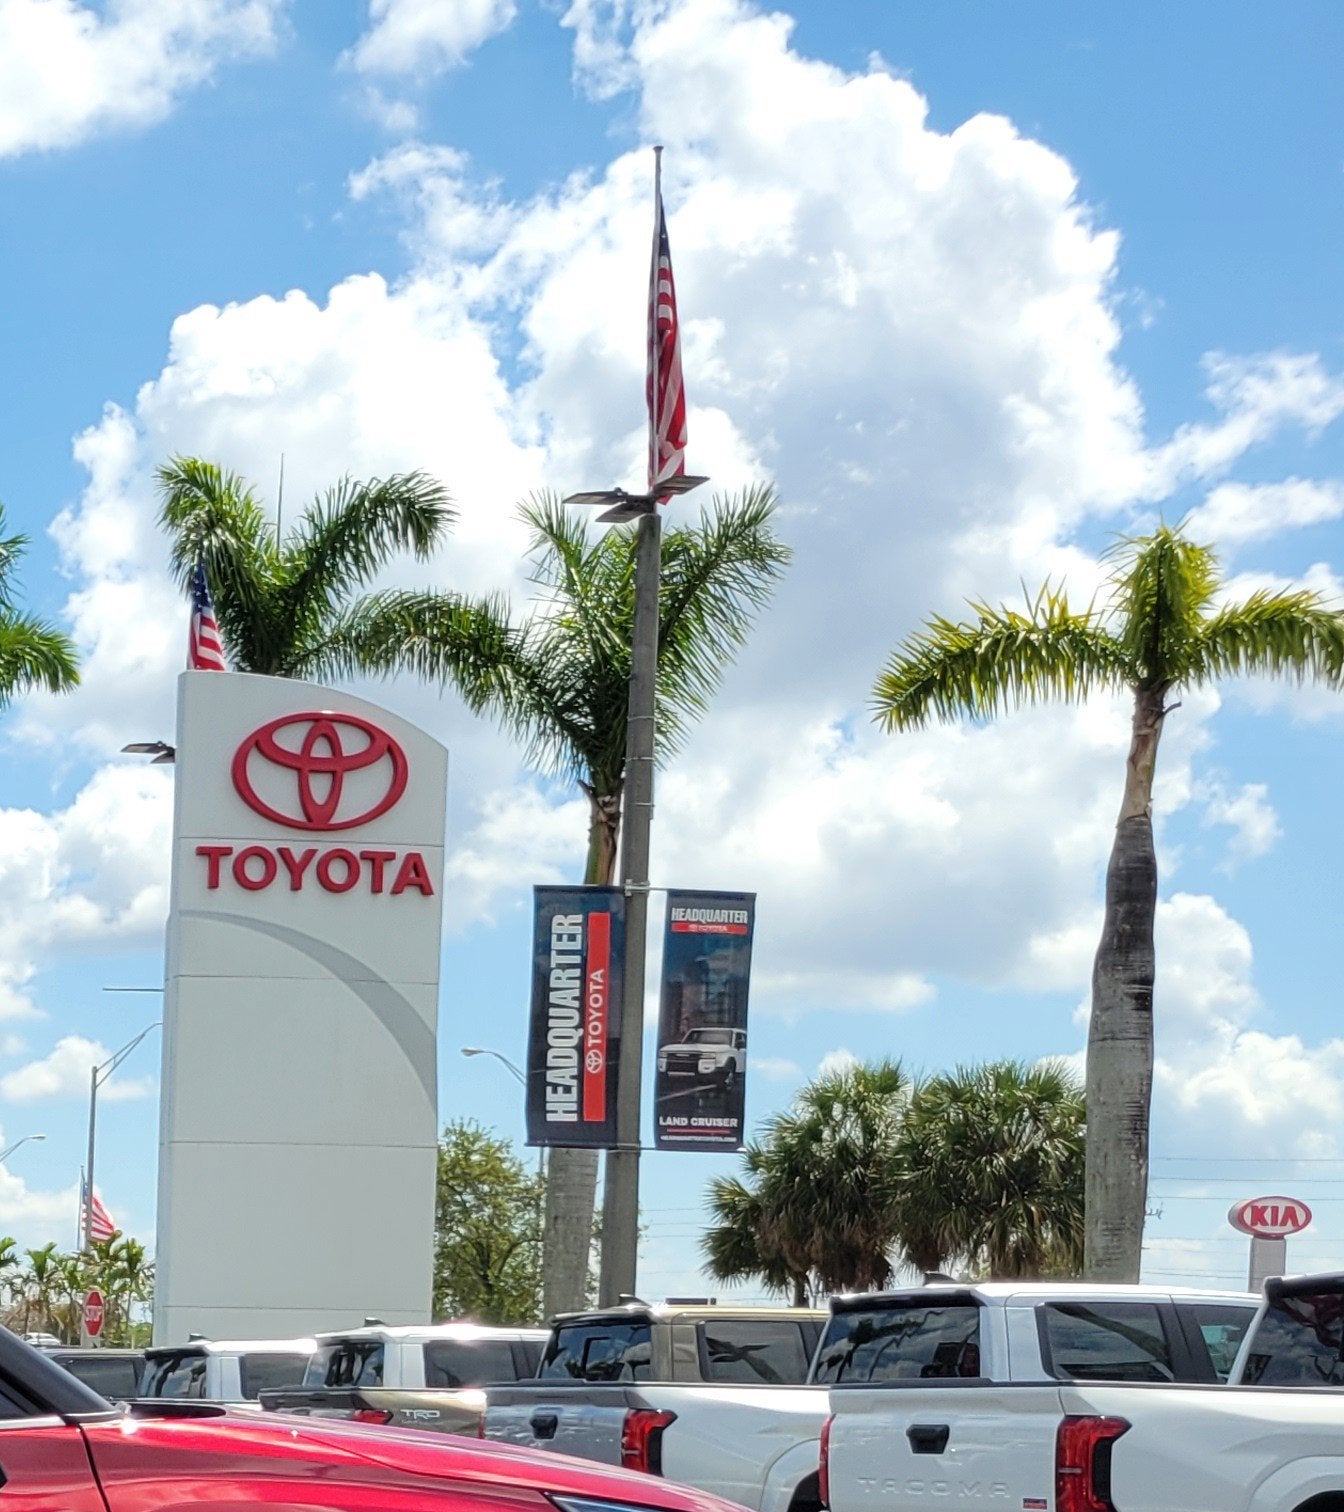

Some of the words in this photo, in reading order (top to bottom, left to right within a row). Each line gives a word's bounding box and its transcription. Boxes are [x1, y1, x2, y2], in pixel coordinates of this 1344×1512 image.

[195, 845, 435, 896] TOYOTA
[671, 907, 749, 924] HEADQUARTER
[545, 913, 585, 1122] HEADQUARTER
[587, 968, 605, 1047] TOYOTA
[658, 1115, 689, 1127] LAND
[690, 1117, 739, 1128] CRUISER
[1250, 1205, 1300, 1227] KIA
[85, 1304, 103, 1322] STOP
[399, 1408, 441, 1420] TRD
[856, 1477, 1011, 1499] TACOMA
